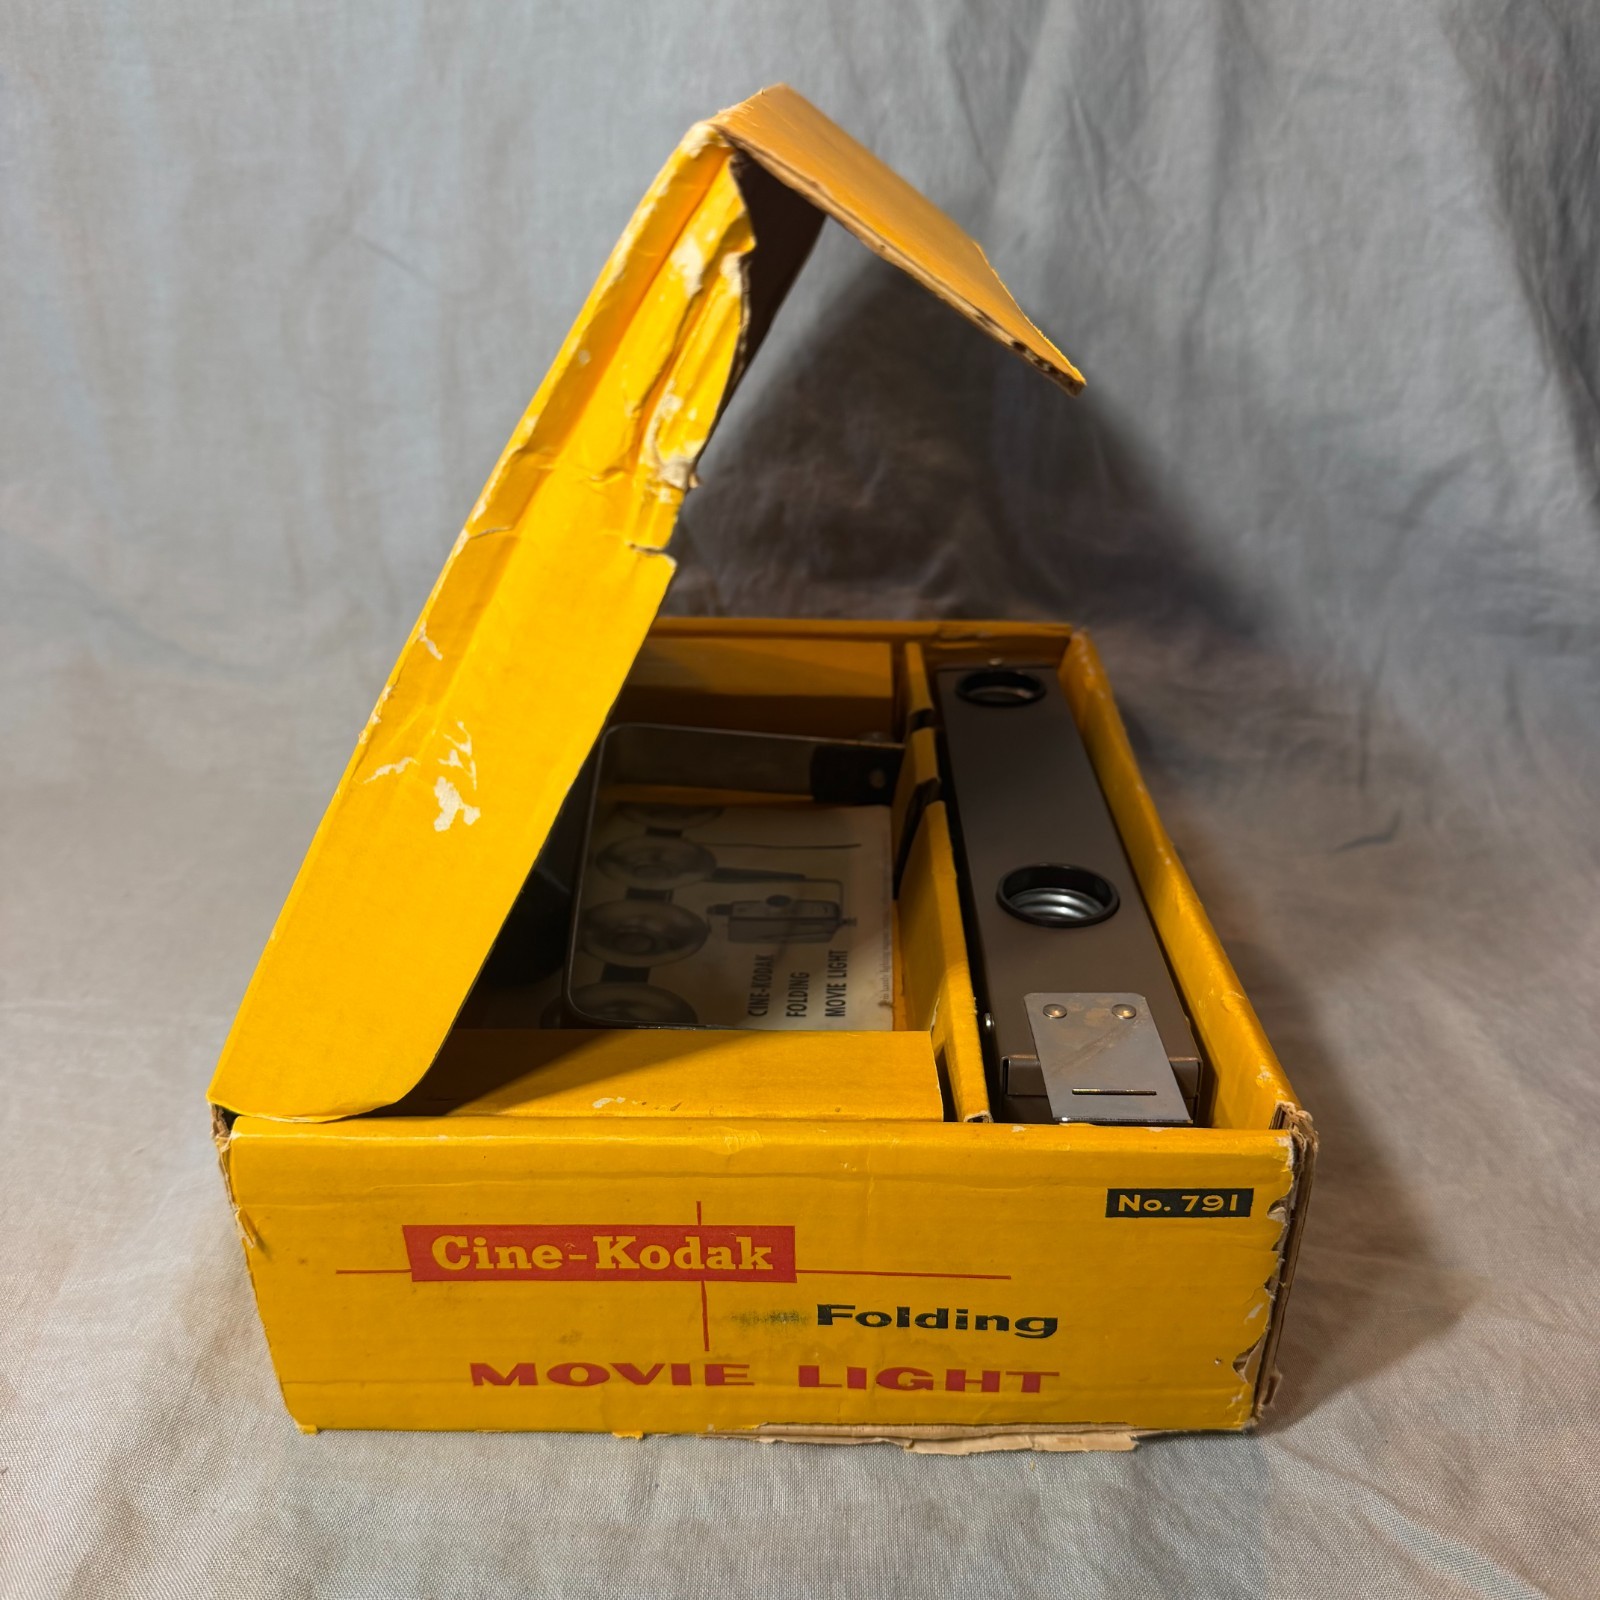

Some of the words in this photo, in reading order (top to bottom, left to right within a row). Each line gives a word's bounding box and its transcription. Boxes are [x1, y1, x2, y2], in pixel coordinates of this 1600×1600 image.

[827, 949, 849, 978] LIGHT
[748, 954, 774, 1017] CINE-KODAK
[786, 972, 810, 1017] FOLDING
[825, 983, 847, 1017] MOVIE
[1117, 1193, 1172, 1212] No.
[1181, 1194, 1238, 1212] 791
[431, 1235, 774, 1272] Cine-Kodak
[816, 1304, 1059, 1339] Folding
[470, 1362, 755, 1386] MOVIE
[798, 1364, 1060, 1393] LIGHT
